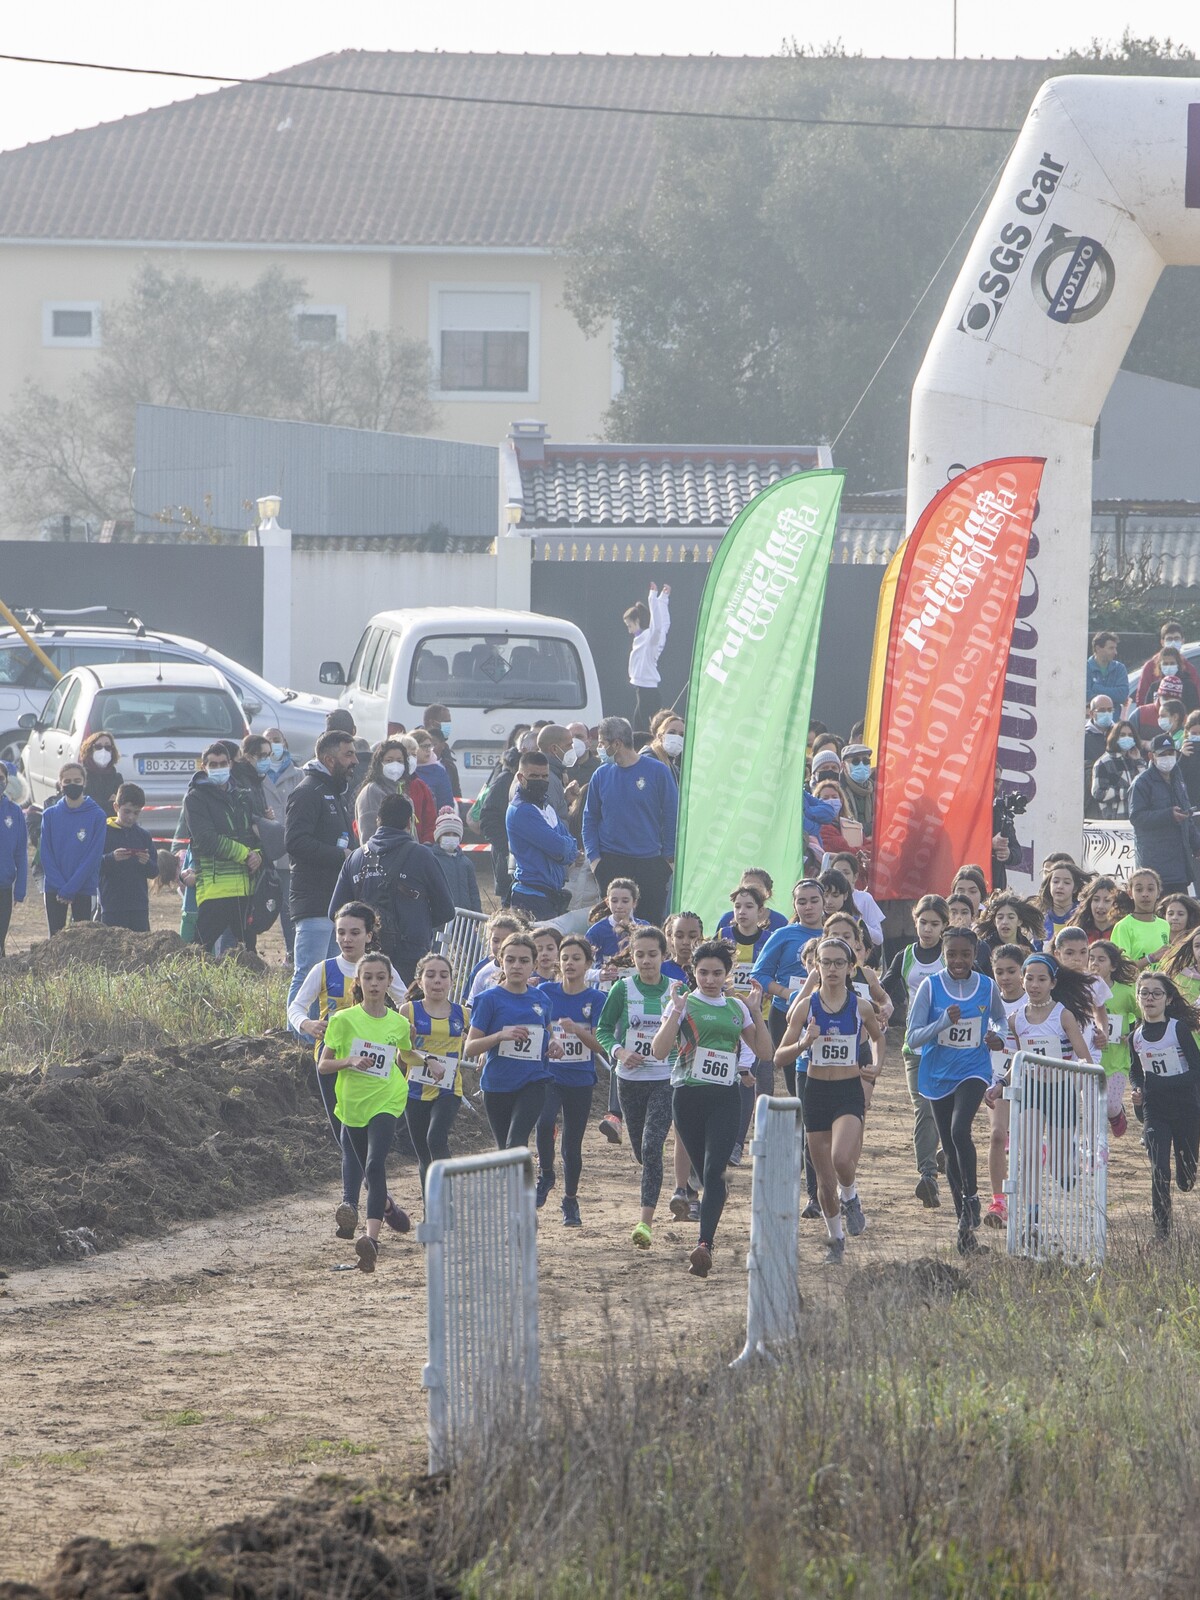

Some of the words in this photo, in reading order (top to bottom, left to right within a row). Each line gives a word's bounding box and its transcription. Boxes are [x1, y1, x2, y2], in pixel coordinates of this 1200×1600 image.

[978, 222, 1033, 298] SGS
[1015, 152, 1064, 215] Car
[1054, 245, 1093, 314] VOLVO
[748, 505, 824, 640] conquista
[903, 509, 986, 651] Palmela
[946, 489, 1021, 613] conquista
[704, 529, 788, 684] Palmela
[724, 559, 755, 615] Município
[930, 543, 1024, 720] Desporto
[562, 1041, 583, 1056] 30
[634, 1041, 655, 1057] 28
[821, 1044, 849, 1060] 659
[949, 1027, 972, 1042] 621
[702, 1059, 729, 1078] 566
[1151, 1059, 1168, 1075] 61
